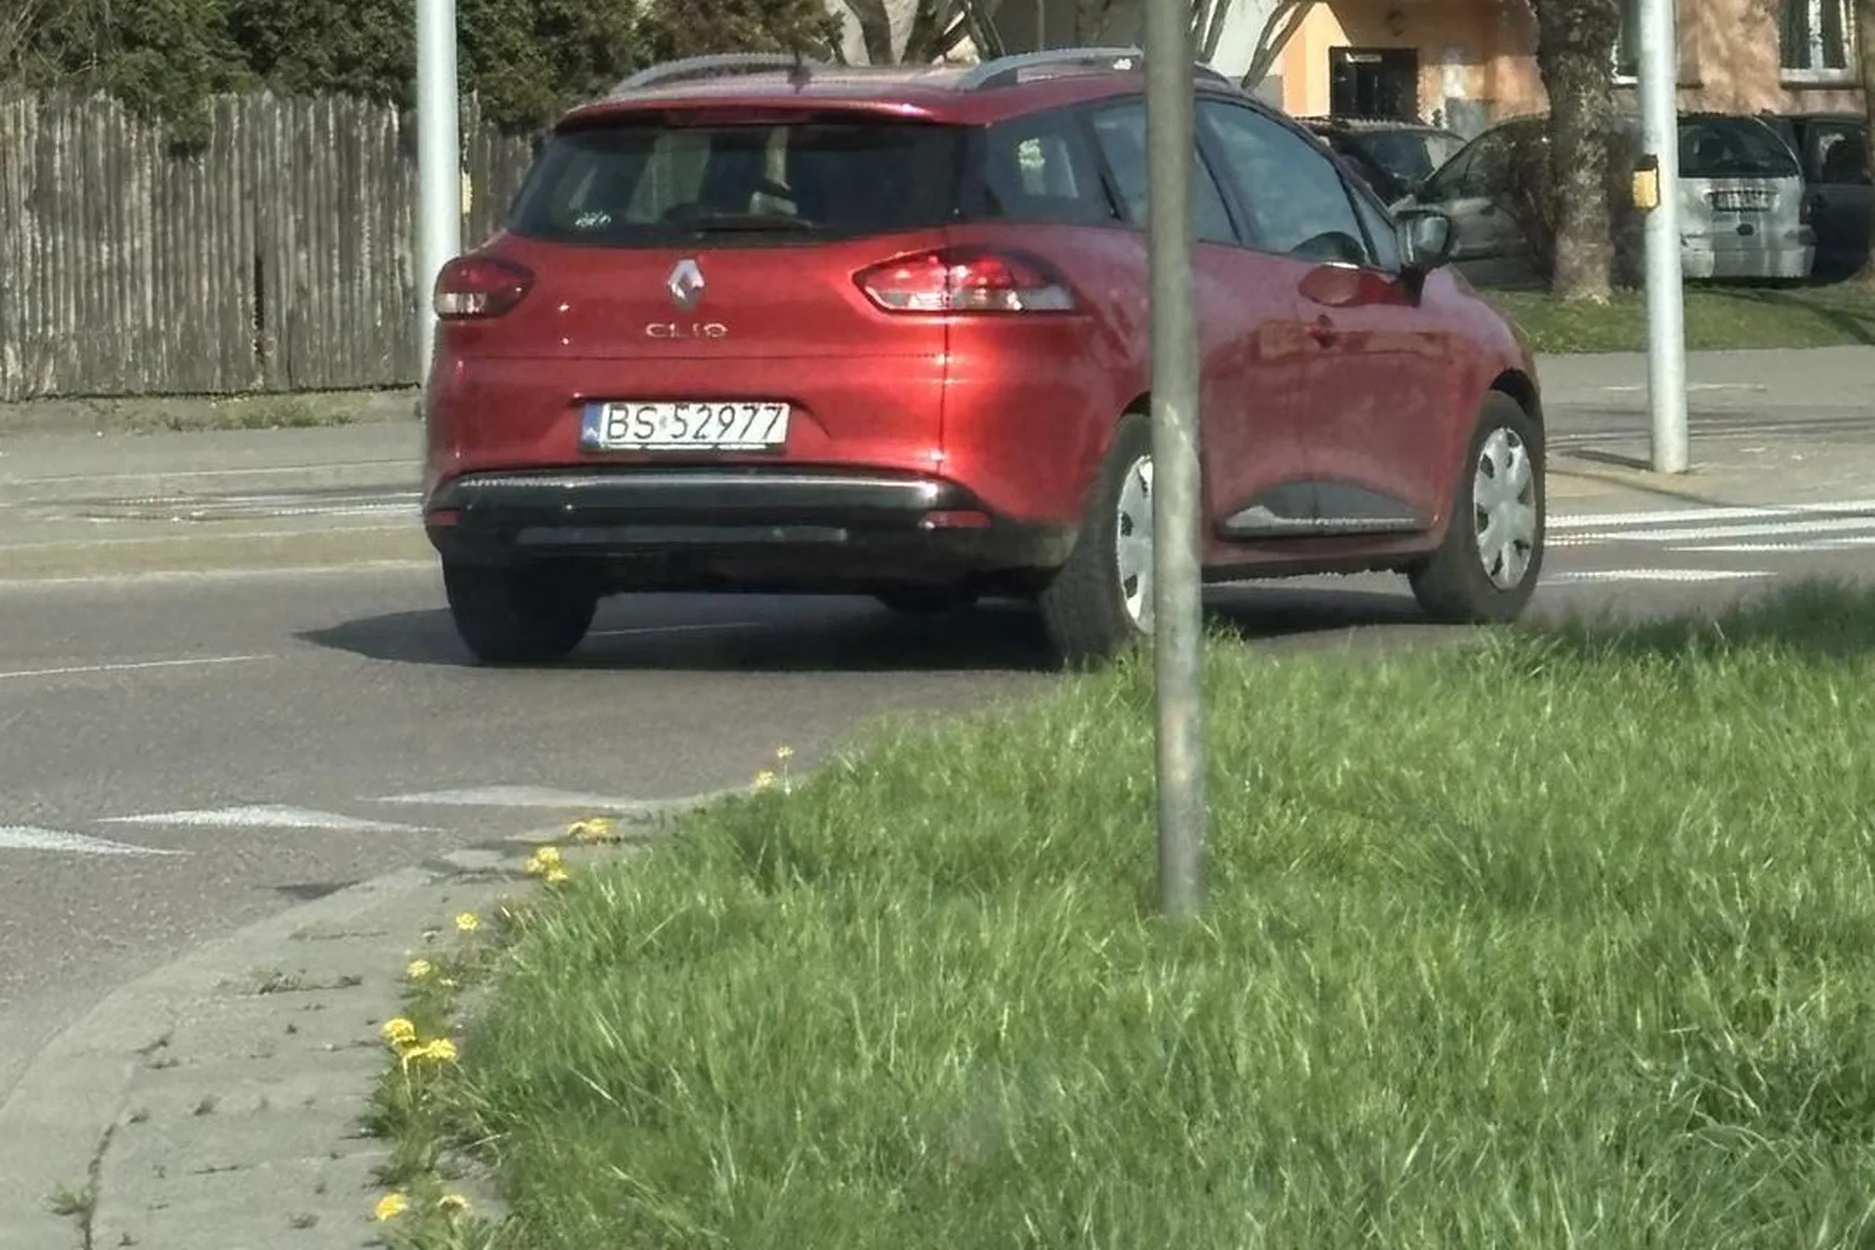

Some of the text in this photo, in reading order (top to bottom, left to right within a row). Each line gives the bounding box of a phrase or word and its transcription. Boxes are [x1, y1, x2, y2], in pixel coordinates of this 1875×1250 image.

[645, 322, 728, 338] CLIO
[607, 405, 658, 440] BS
[670, 403, 784, 440] 52977
